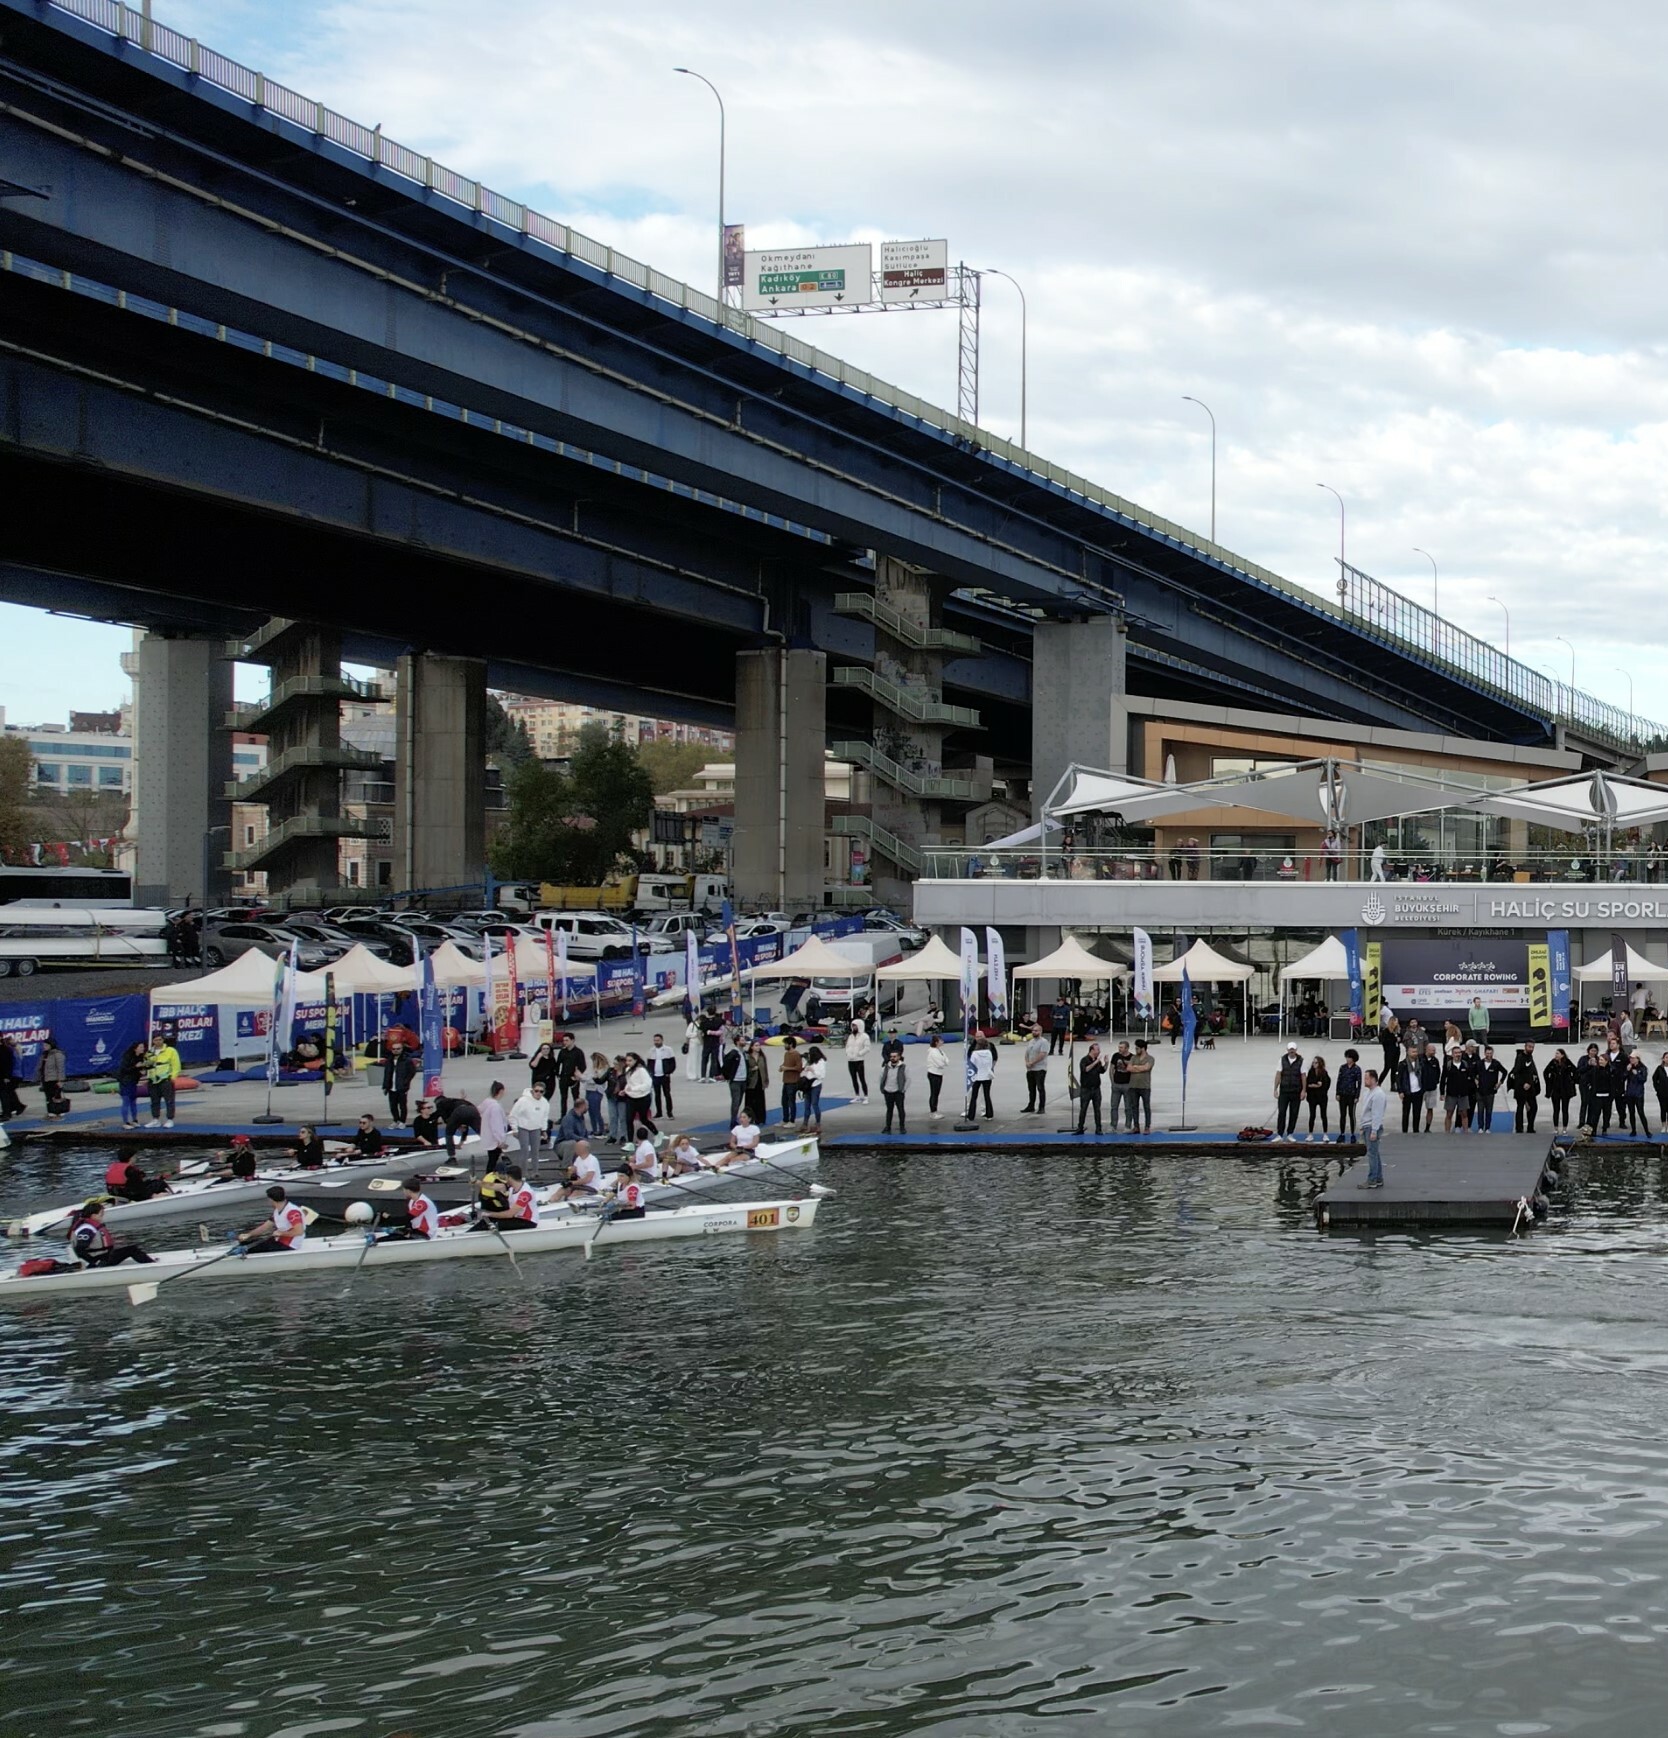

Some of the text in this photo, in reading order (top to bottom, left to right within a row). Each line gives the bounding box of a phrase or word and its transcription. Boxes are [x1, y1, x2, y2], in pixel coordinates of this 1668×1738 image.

[761, 253, 815, 262] Okmeydanı
[761, 263, 813, 273] Kağıthane
[761, 275, 800, 283] Kadıköy
[884, 277, 943, 287] Kongre Merkezi
[762, 285, 797, 293] Ankara
[1394, 903, 1459, 914] BÜYÜKŞEHİR
[1491, 898, 1556, 920] HALİÇ
[1561, 901, 1590, 918] SU
[1394, 914, 1440, 922] BELEDİYESİ
[1437, 928, 1461, 936] Kürek
[1468, 928, 1509, 937] Kayıkhane
[1433, 973, 1518, 981] CORPORATE ROWING
[158, 1005, 206, 1017] İBB HALİÇ
[296, 1010, 307, 1019] SU
[4, 1015, 42, 1029] HALİÇ
[751, 1213, 775, 1226] 401
